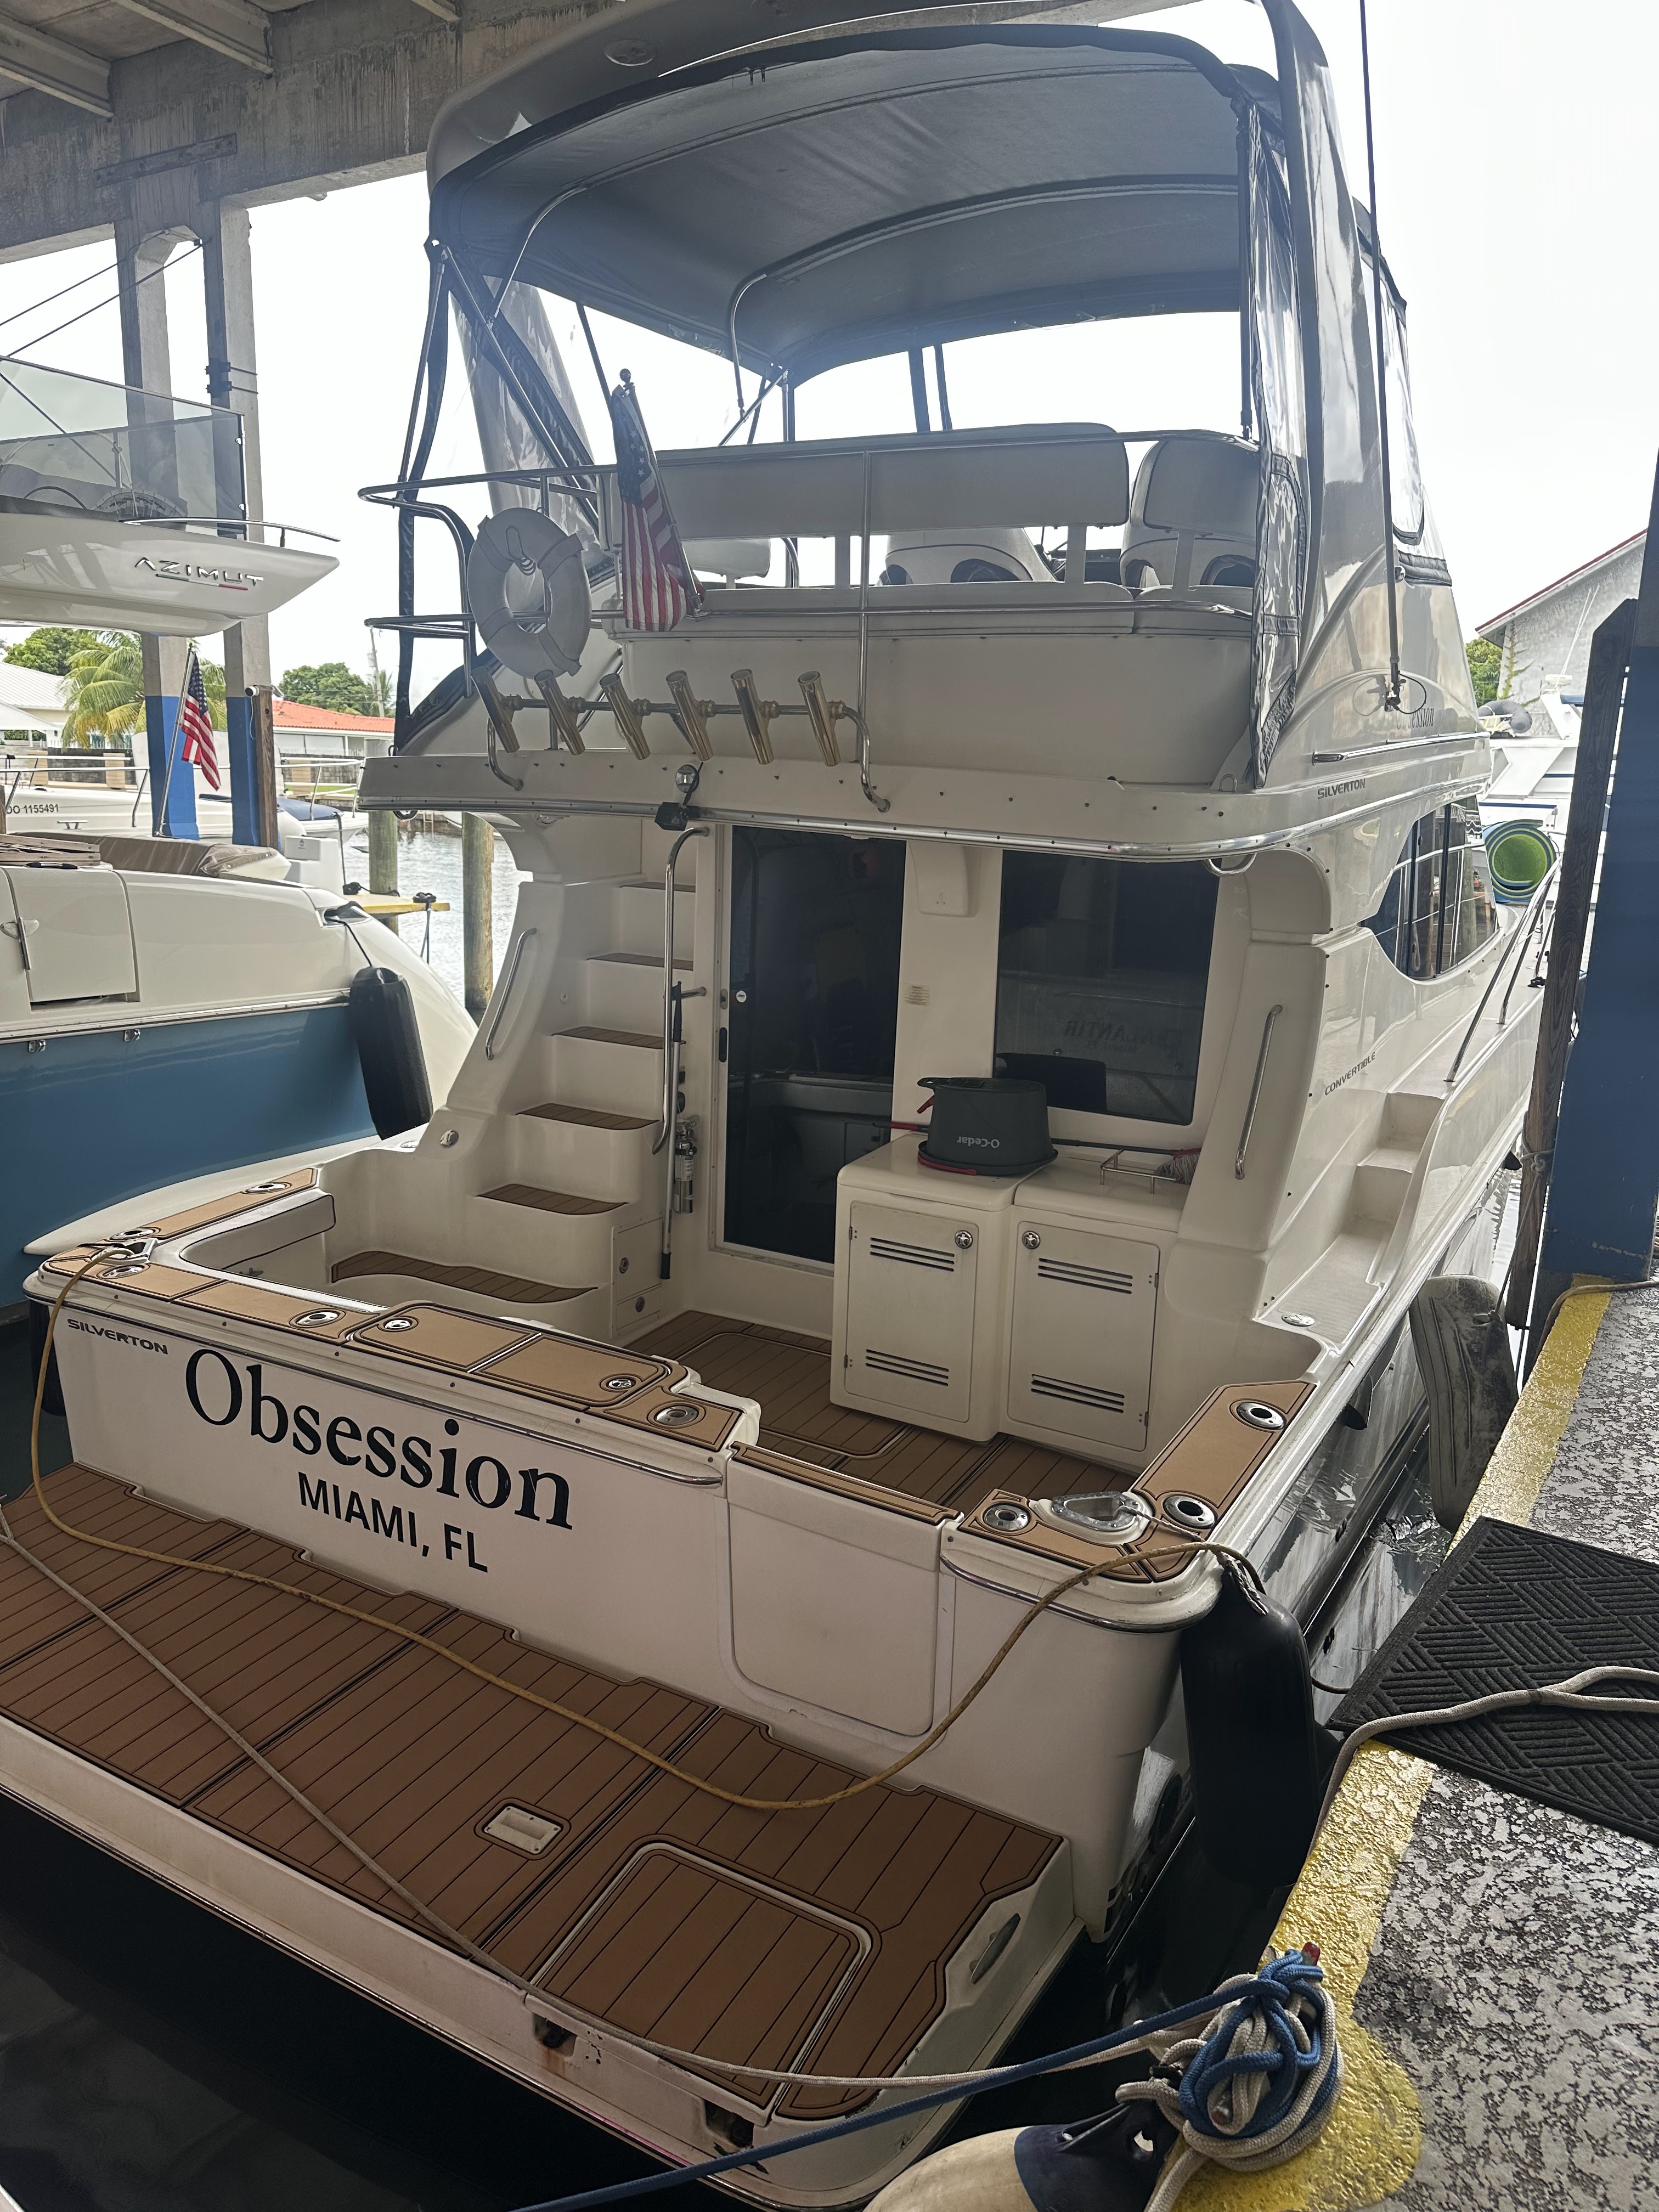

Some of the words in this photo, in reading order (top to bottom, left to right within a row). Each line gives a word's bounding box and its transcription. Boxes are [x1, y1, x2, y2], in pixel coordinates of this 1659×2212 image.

[135, 557, 264, 586] AZIMUT
[1396, 707, 1434, 730] Oession
[1318, 778, 1365, 799] SILVERTON
[23, 804, 59, 814] 1155491
[1325, 1051, 1375, 1096] CONVERTIBLE
[957, 1136, 1000, 1148] O-Cedar
[67, 1318, 168, 1355] SILVERTON
[185, 1348, 573, 1530] Obsession
[297, 1471, 430, 1558] MIAMI,
[443, 1523, 488, 1573] FL
